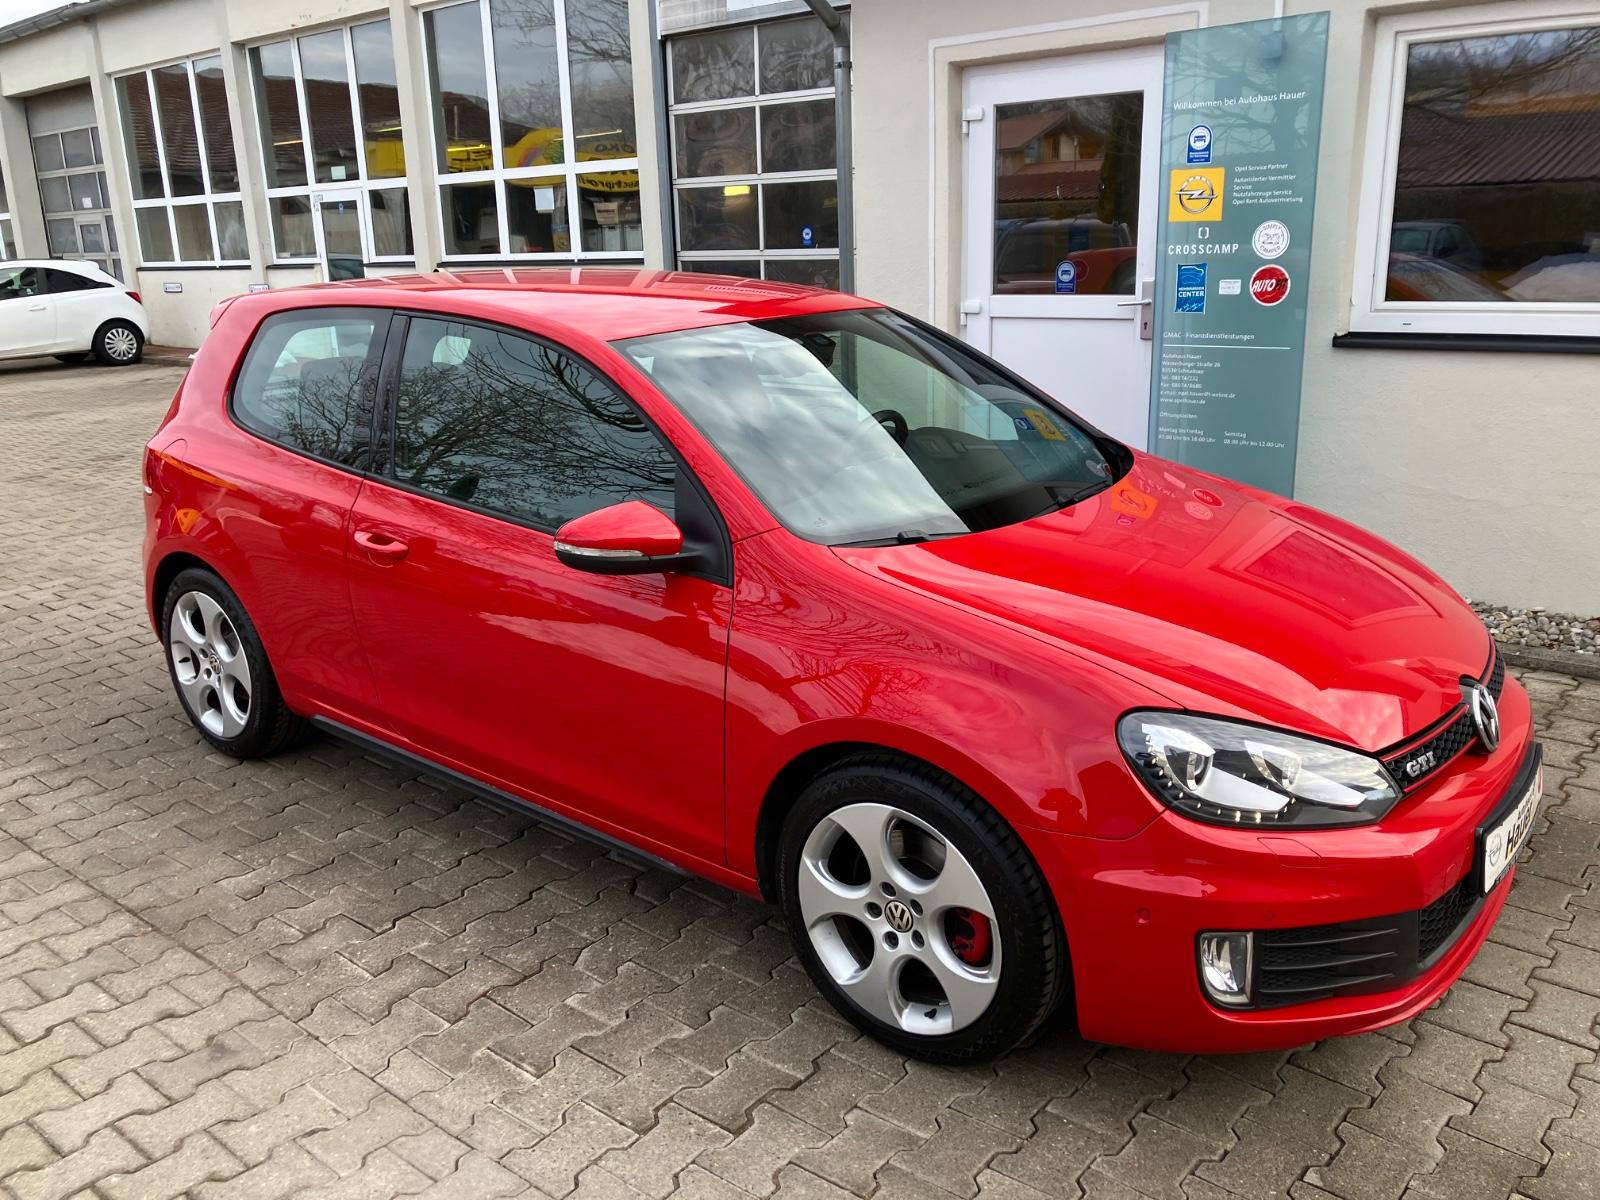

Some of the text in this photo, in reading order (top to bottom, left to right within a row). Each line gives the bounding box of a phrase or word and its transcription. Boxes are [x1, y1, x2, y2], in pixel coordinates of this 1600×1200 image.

[1173, 91, 1307, 111] Willkommen bei Autohaus Hauer
[1234, 165, 1248, 173] Opel
[1232, 198, 1246, 206] Opel
[1168, 243, 1239, 256] CROSSCAMP
[1178, 290, 1205, 298] CENTER
[1186, 332, 1255, 341] Finanzdienstleistungen
[1224, 430, 1247, 439] Samstag
[1406, 750, 1437, 778] GTI
